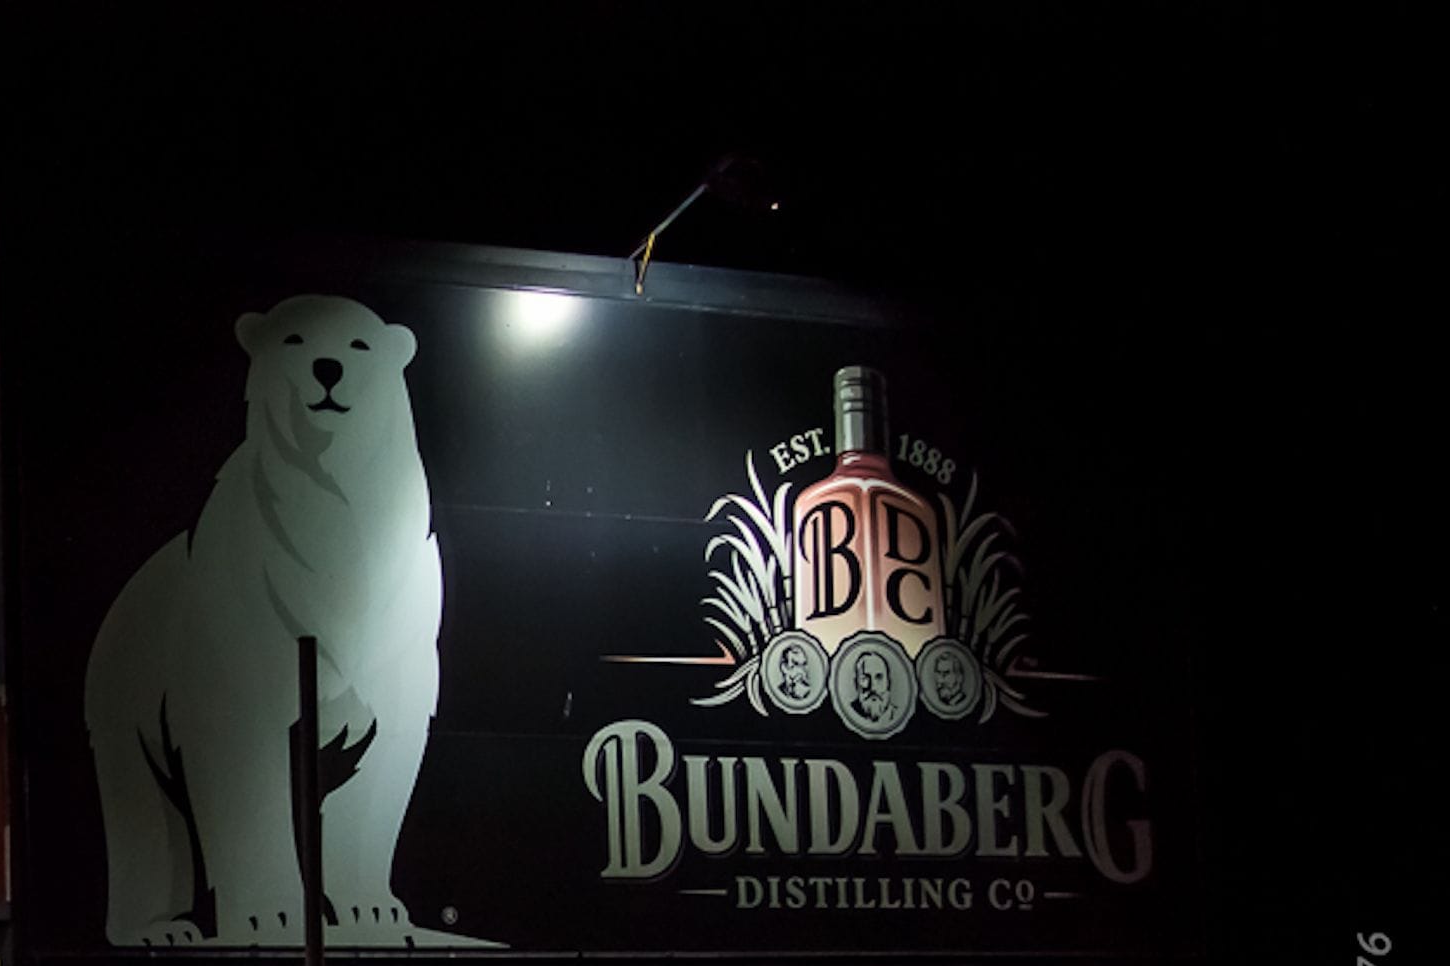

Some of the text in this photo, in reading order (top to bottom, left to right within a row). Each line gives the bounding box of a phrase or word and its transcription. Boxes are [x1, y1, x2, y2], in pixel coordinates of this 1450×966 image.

[769, 427, 957, 485] EST. 1888
[799, 501, 931, 620] B D
[886, 569, 933, 623] C
[581, 718, 1153, 885] BUNDABERG
[736, 875, 973, 911] DISTILLING
